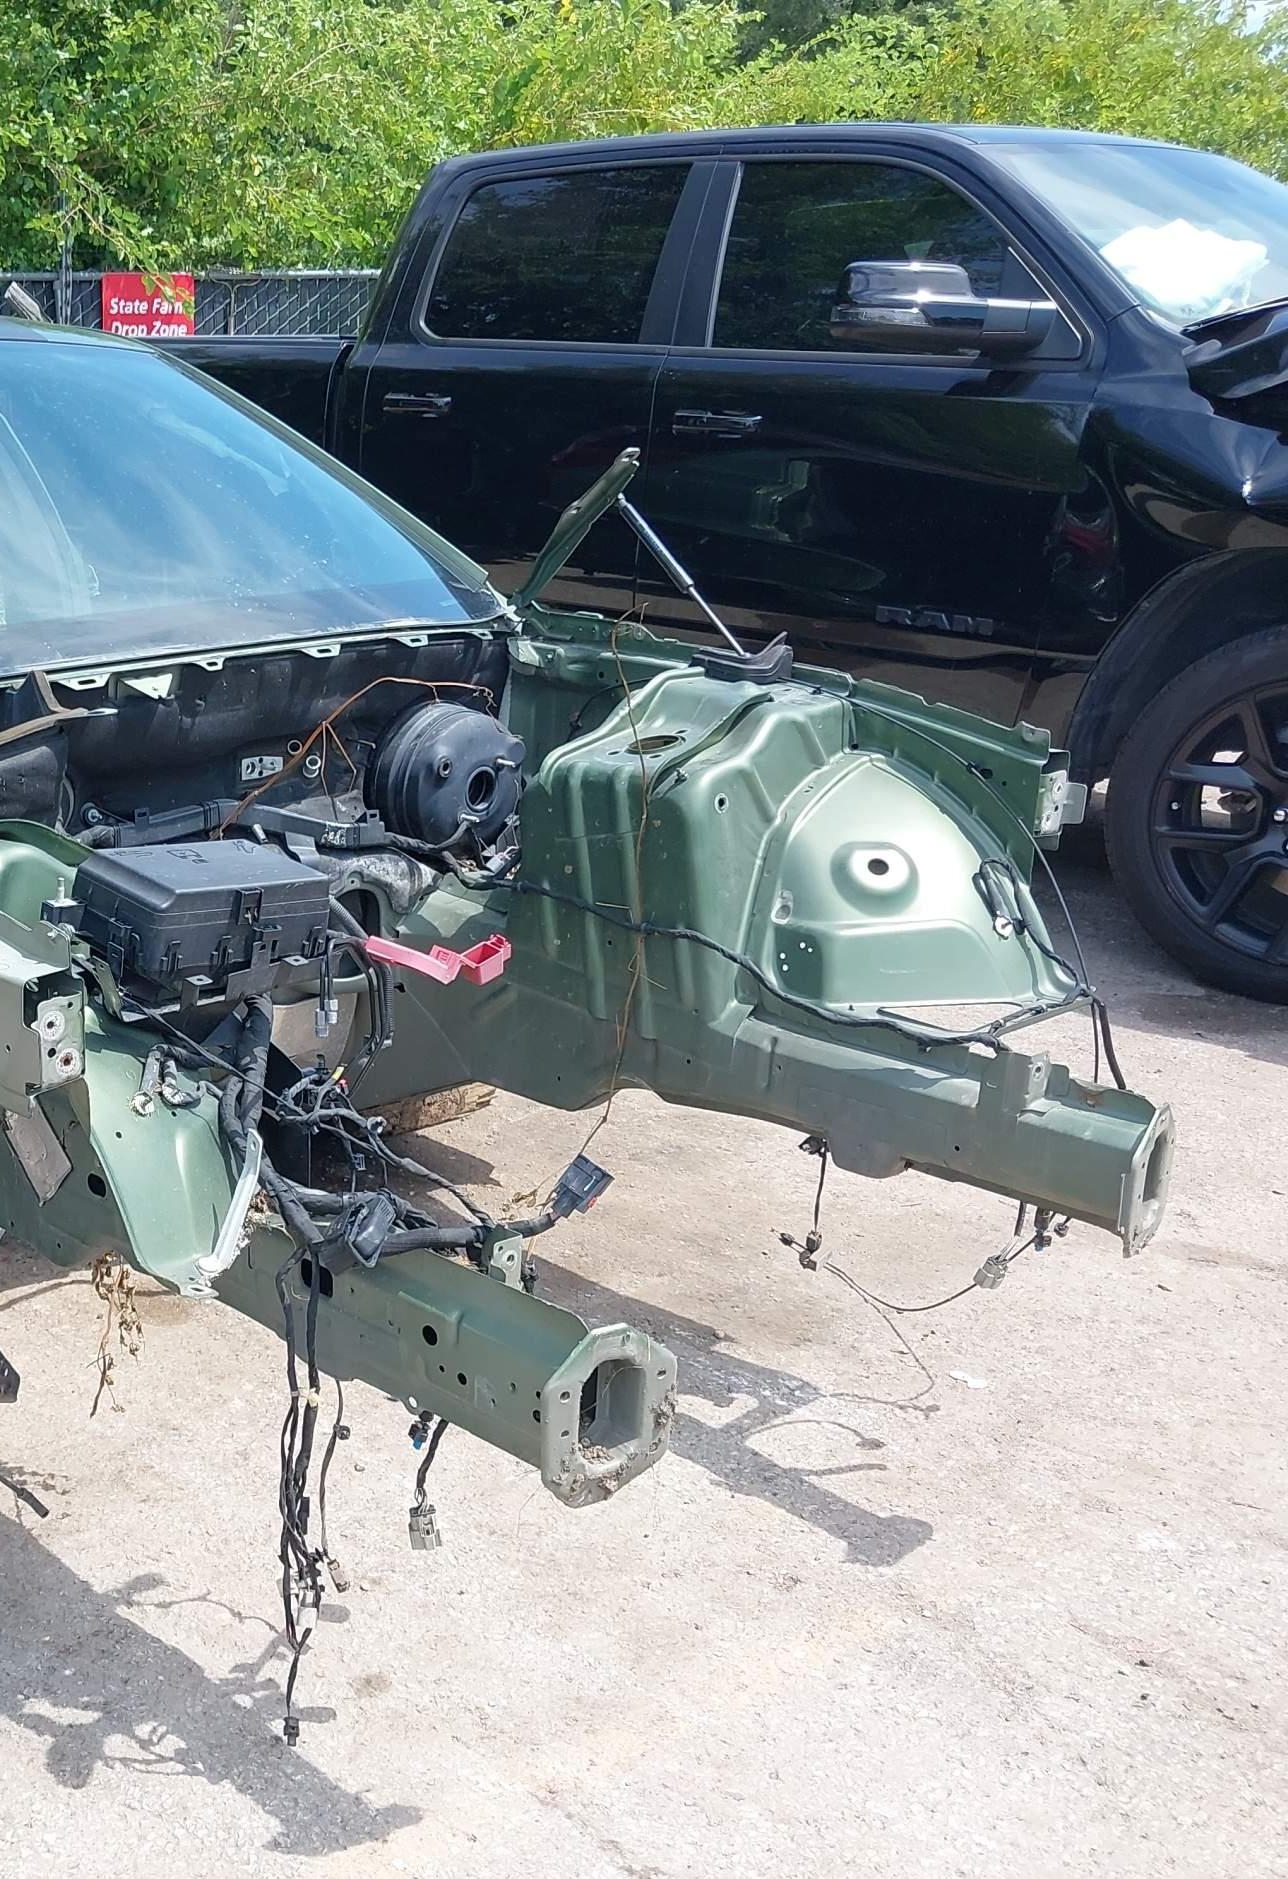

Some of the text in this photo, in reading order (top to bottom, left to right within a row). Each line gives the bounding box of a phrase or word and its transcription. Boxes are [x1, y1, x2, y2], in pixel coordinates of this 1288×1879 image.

[110, 297, 148, 314] State
[150, 320, 187, 336] Zone
[875, 604, 993, 636] RAM
